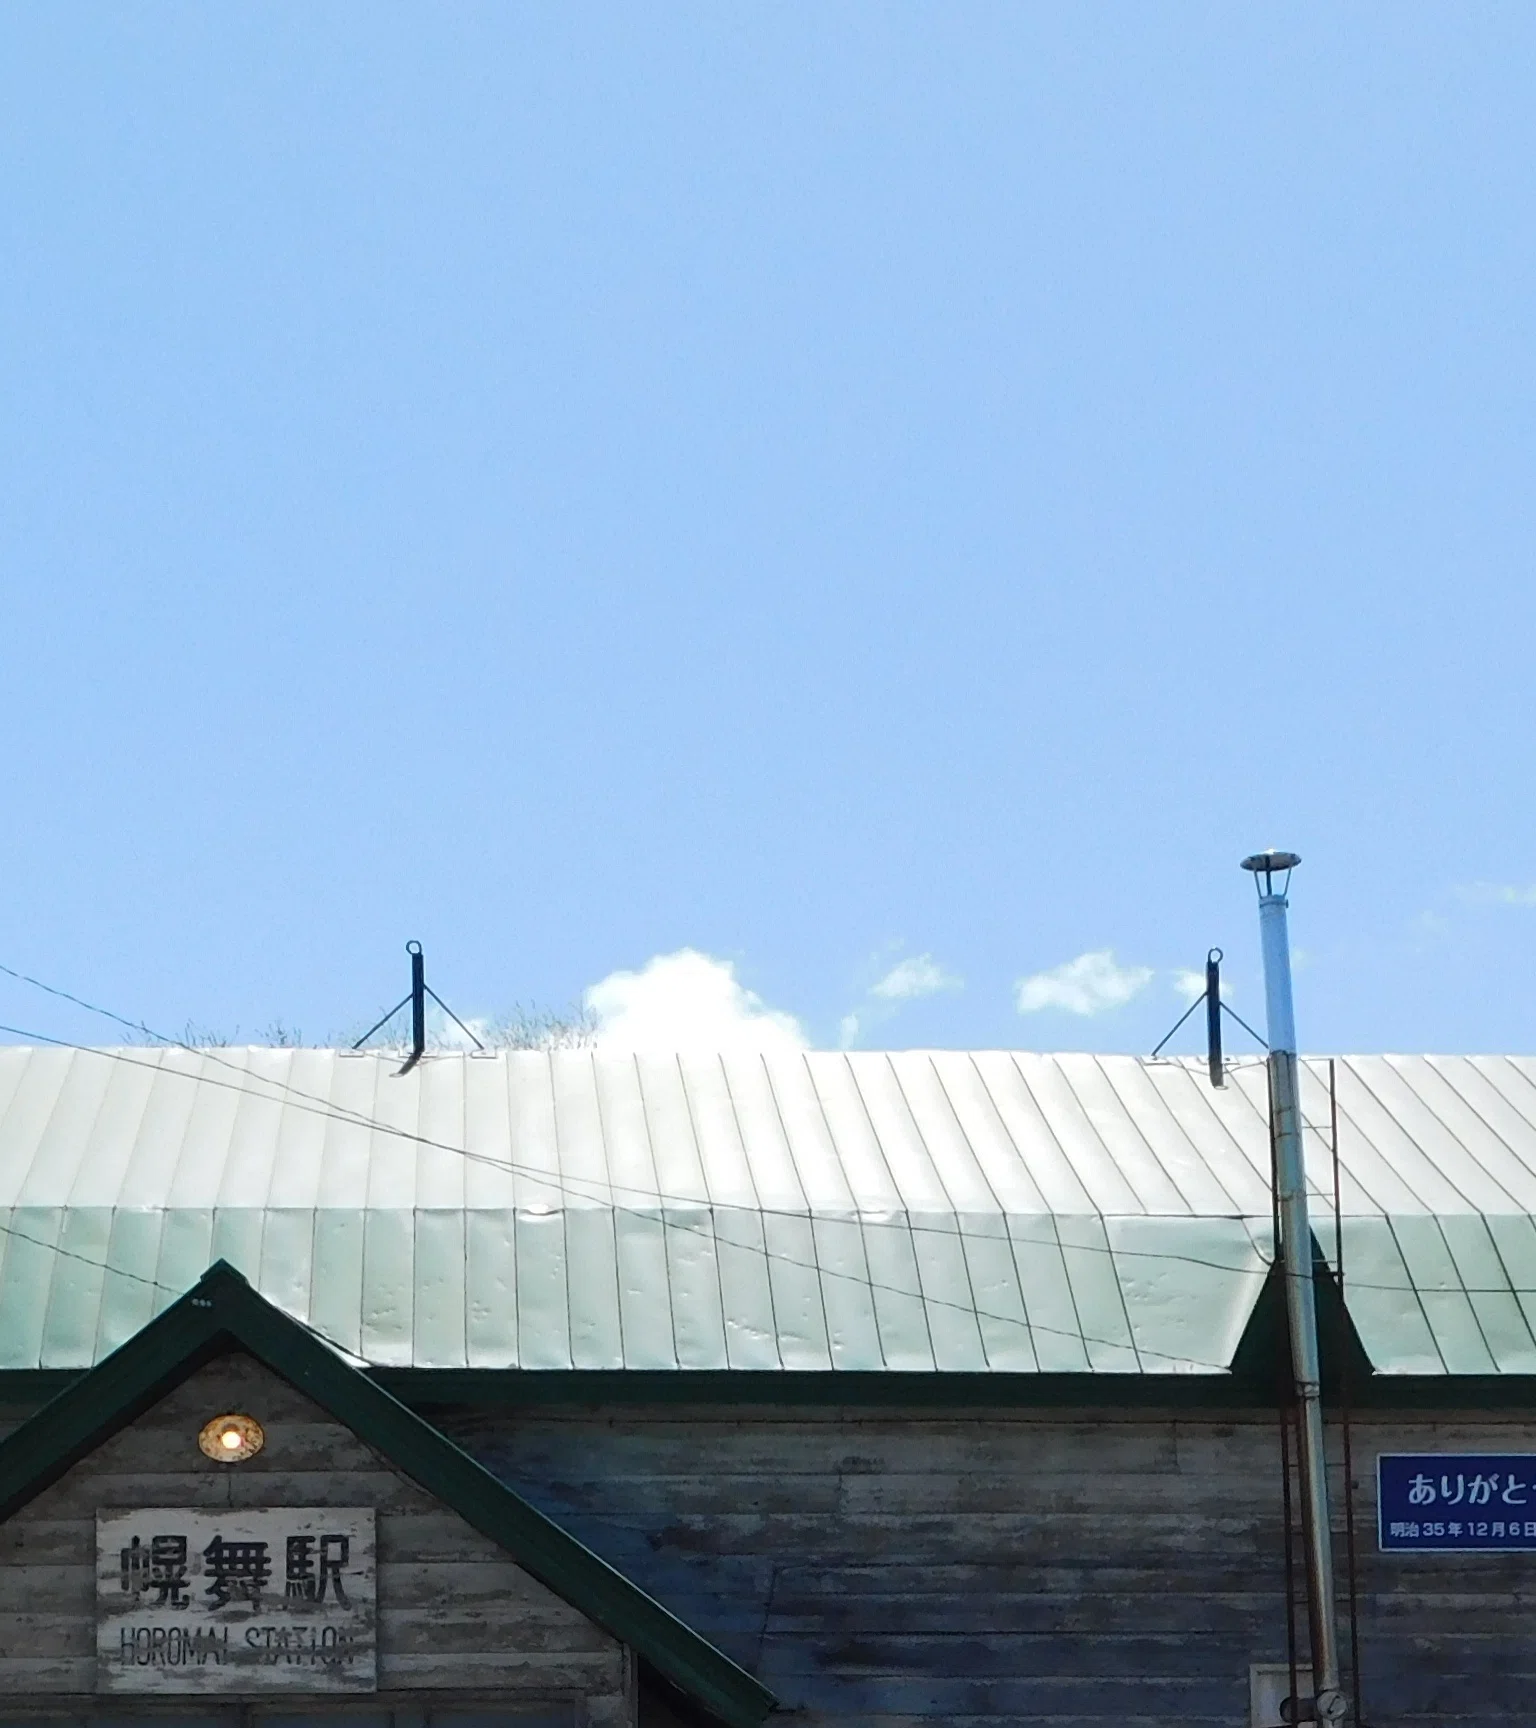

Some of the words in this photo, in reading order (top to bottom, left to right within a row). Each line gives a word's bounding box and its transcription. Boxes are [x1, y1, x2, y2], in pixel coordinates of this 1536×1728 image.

[120, 1535, 354, 1612] 幌舞駅
[120, 1626, 229, 1667] HOROMAI
[245, 1626, 354, 1667] STATION
